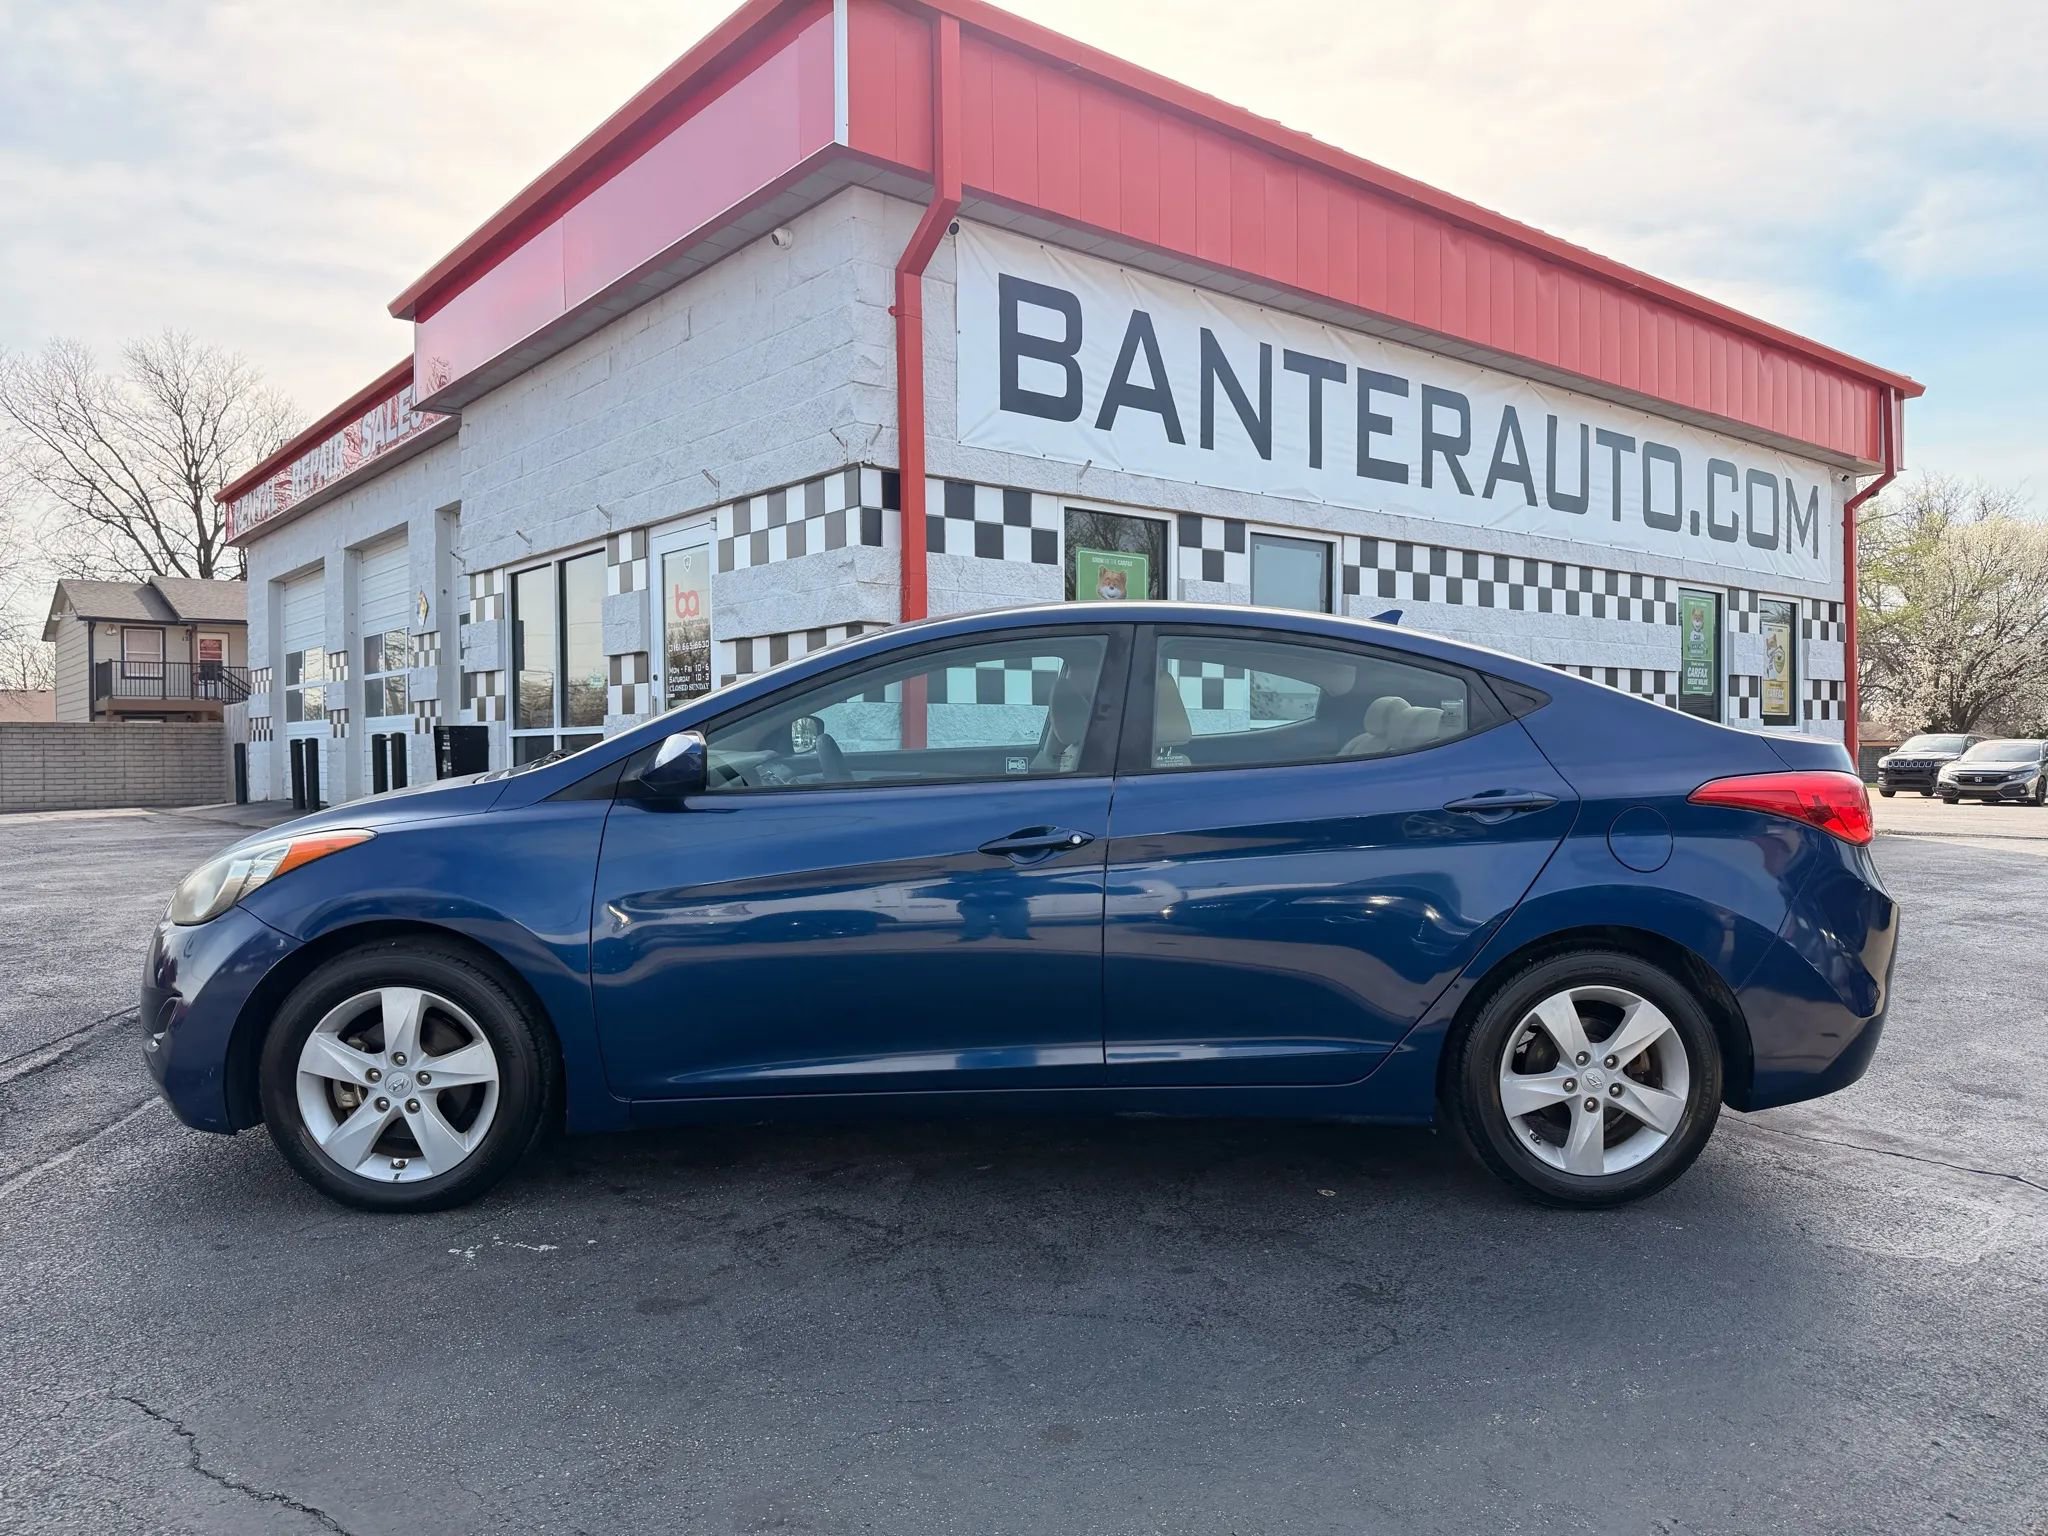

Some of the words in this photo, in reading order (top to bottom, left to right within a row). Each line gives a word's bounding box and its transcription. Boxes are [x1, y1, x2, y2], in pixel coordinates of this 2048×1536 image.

[998, 272, 1821, 560] BANTERAUTO.COM
[291, 431, 346, 499] REPAIR
[669, 676, 690, 684] SATURDAY
[669, 684, 688, 692] CLOSED
[689, 682, 709, 690] SUNDAY
